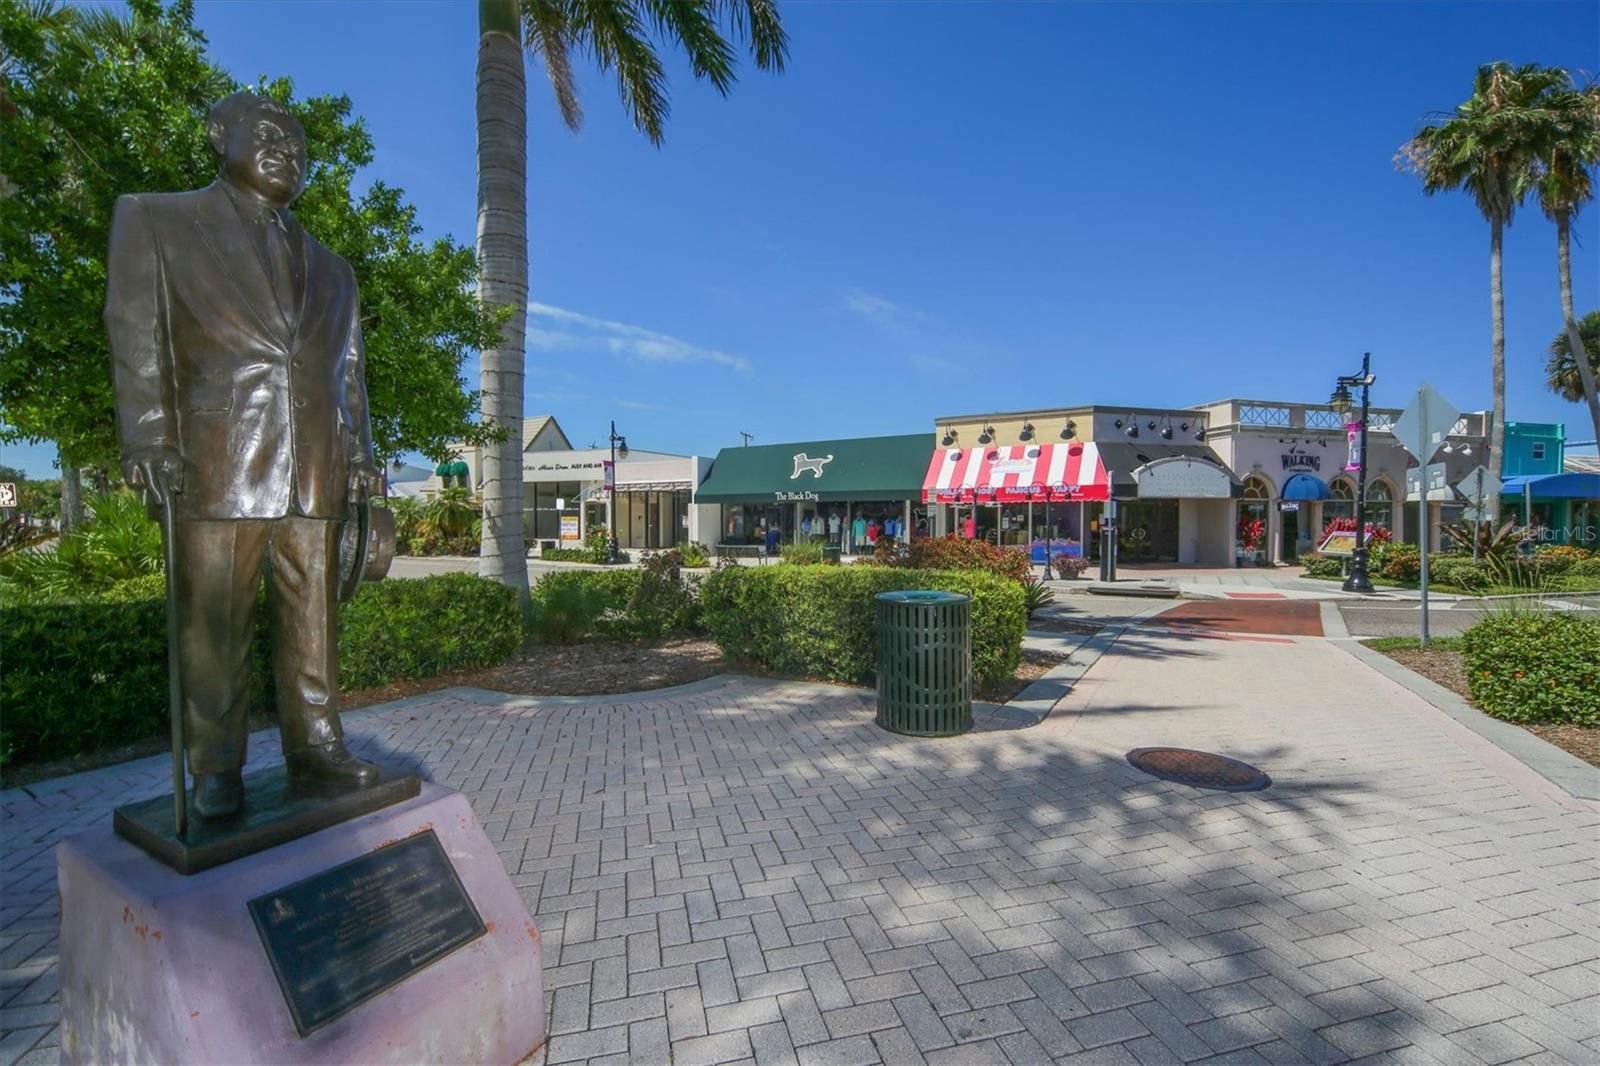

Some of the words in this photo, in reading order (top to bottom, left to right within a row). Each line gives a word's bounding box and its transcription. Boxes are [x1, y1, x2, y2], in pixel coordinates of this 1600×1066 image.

[1281, 455, 1320, 472] WALKING
[775, 491, 787, 501] The
[788, 491, 804, 501] Black
[805, 490, 819, 502] Dog
